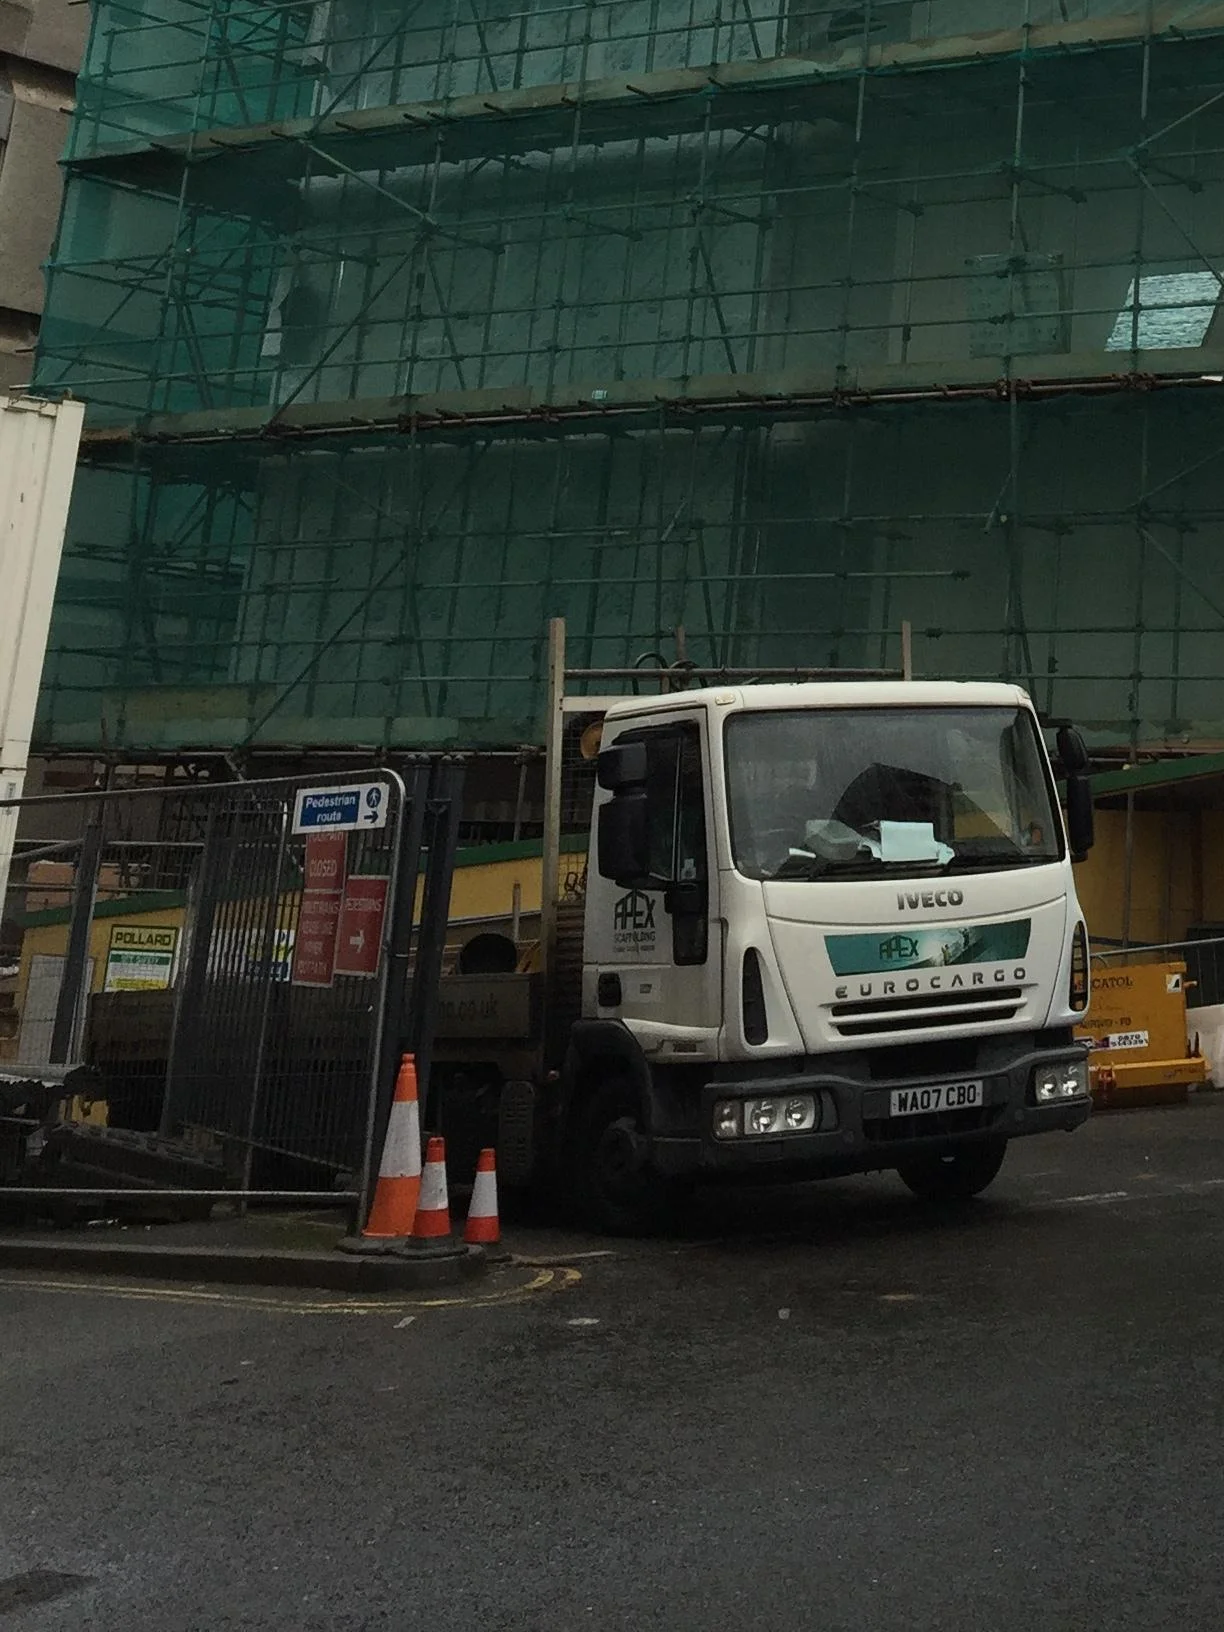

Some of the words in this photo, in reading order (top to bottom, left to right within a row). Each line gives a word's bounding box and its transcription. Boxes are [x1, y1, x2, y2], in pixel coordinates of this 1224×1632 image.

[305, 795, 356, 809] Pedestrian
[316, 811, 342, 823] route
[614, 890, 656, 930] APEX
[897, 890, 964, 911] IVECO
[115, 932, 172, 946] POLLARD
[879, 935, 919, 960] APEX
[835, 967, 1027, 999] EUROCARGO
[898, 1088, 942, 1113] WA07
[945, 1084, 977, 1107] CBO
